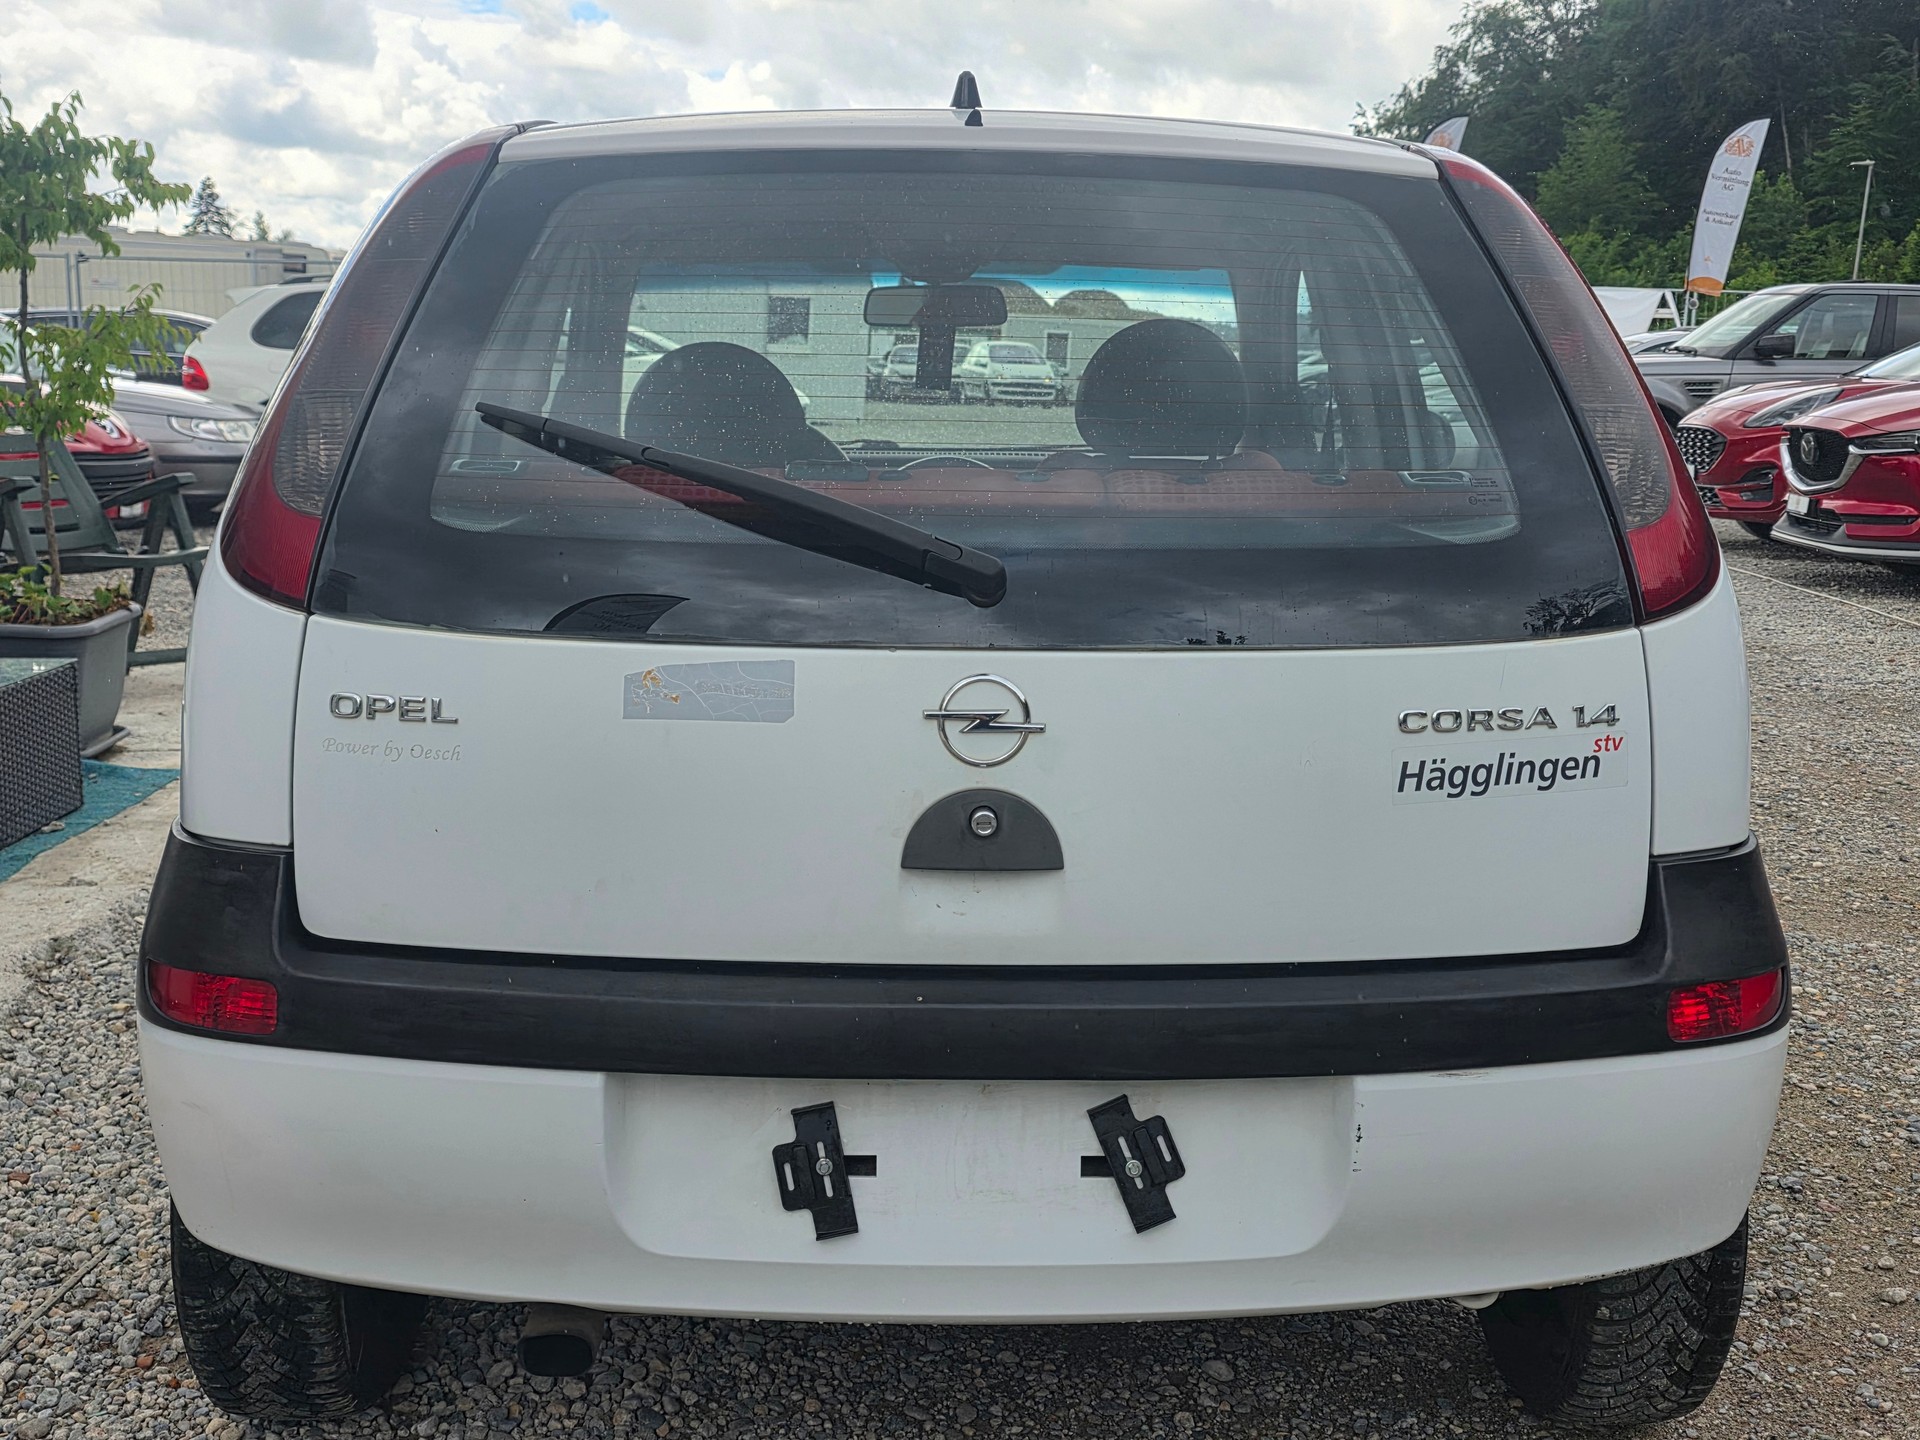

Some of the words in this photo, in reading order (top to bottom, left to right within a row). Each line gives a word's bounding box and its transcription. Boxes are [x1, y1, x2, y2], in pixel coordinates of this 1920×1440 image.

[1723, 167, 1742, 176] Auto
[1722, 183, 1735, 191] AG
[330, 692, 458, 724] OPEL
[1398, 706, 1558, 733] CORSA
[322, 737, 379, 755] Power
[383, 740, 403, 762] by
[410, 744, 461, 761] Oesch
[1593, 734, 1624, 753] stv
[1397, 752, 1601, 798] Hägglingen
